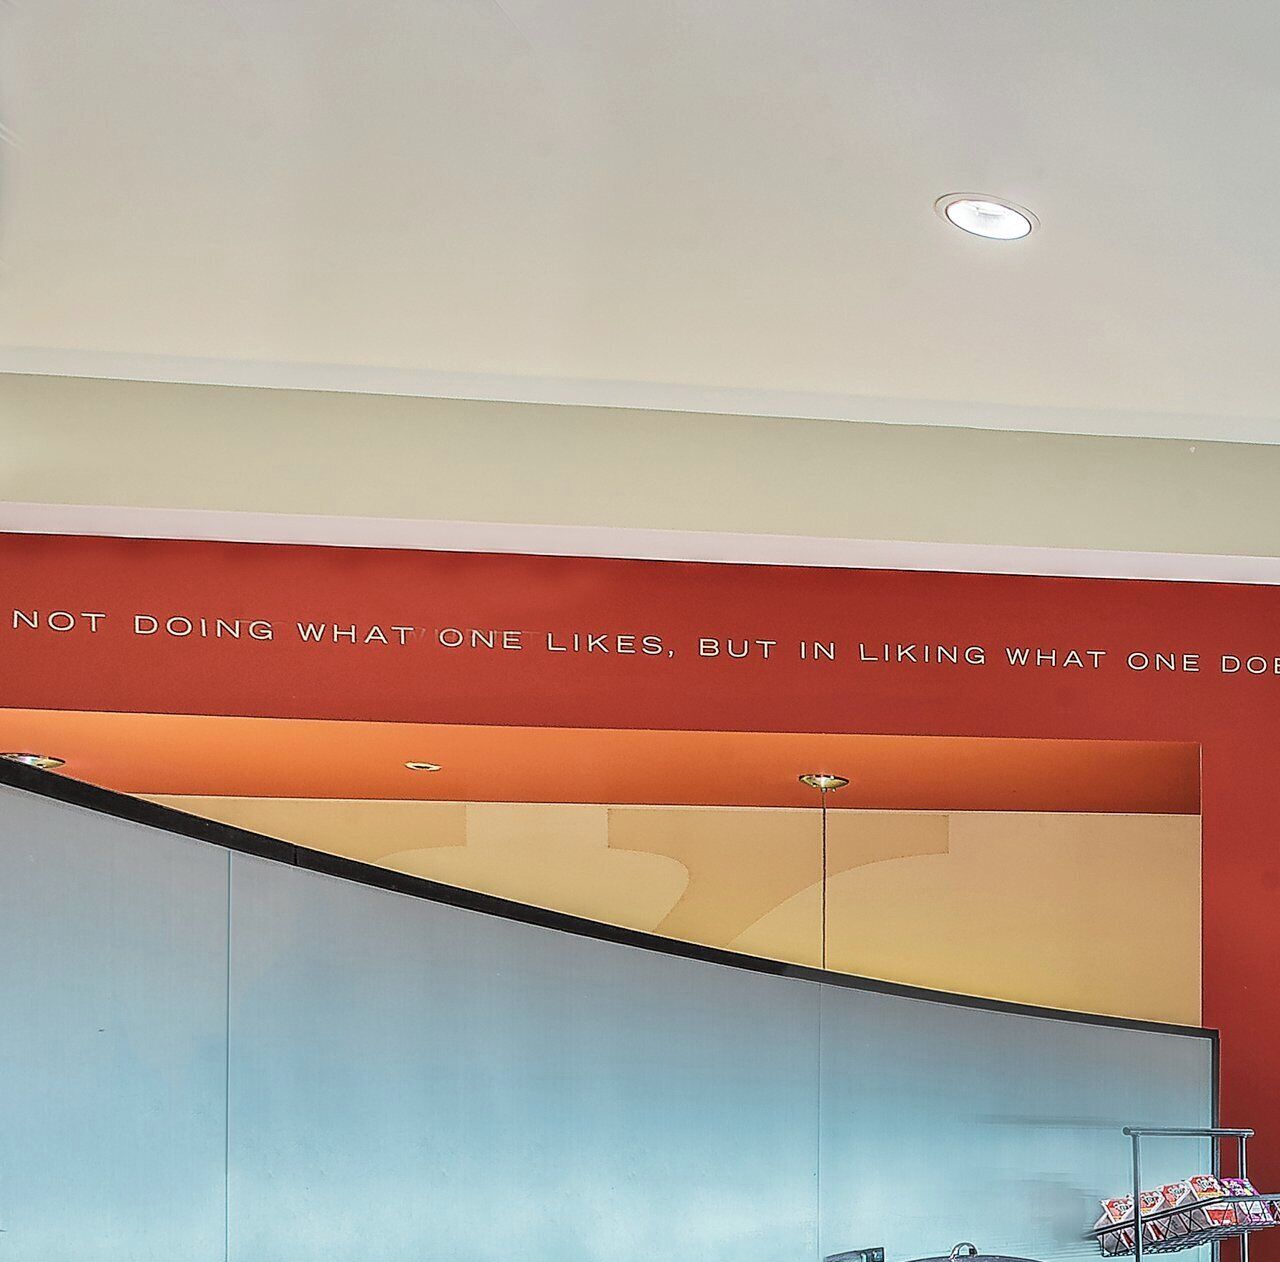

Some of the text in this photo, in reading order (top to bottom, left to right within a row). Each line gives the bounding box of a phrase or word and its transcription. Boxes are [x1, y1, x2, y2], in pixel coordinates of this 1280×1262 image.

[12, 609, 106, 633] NOT
[133, 615, 274, 641] DOING
[296, 622, 415, 646] WHAT
[438, 627, 523, 651] ONE
[547, 631, 675, 658] LIKES,
[698, 638, 778, 659] BUT
[800, 641, 835, 660] IN
[858, 643, 986, 666] LIKING
[1005, 646, 1106, 669] WHAT
[1126, 652, 1201, 673] ONE
